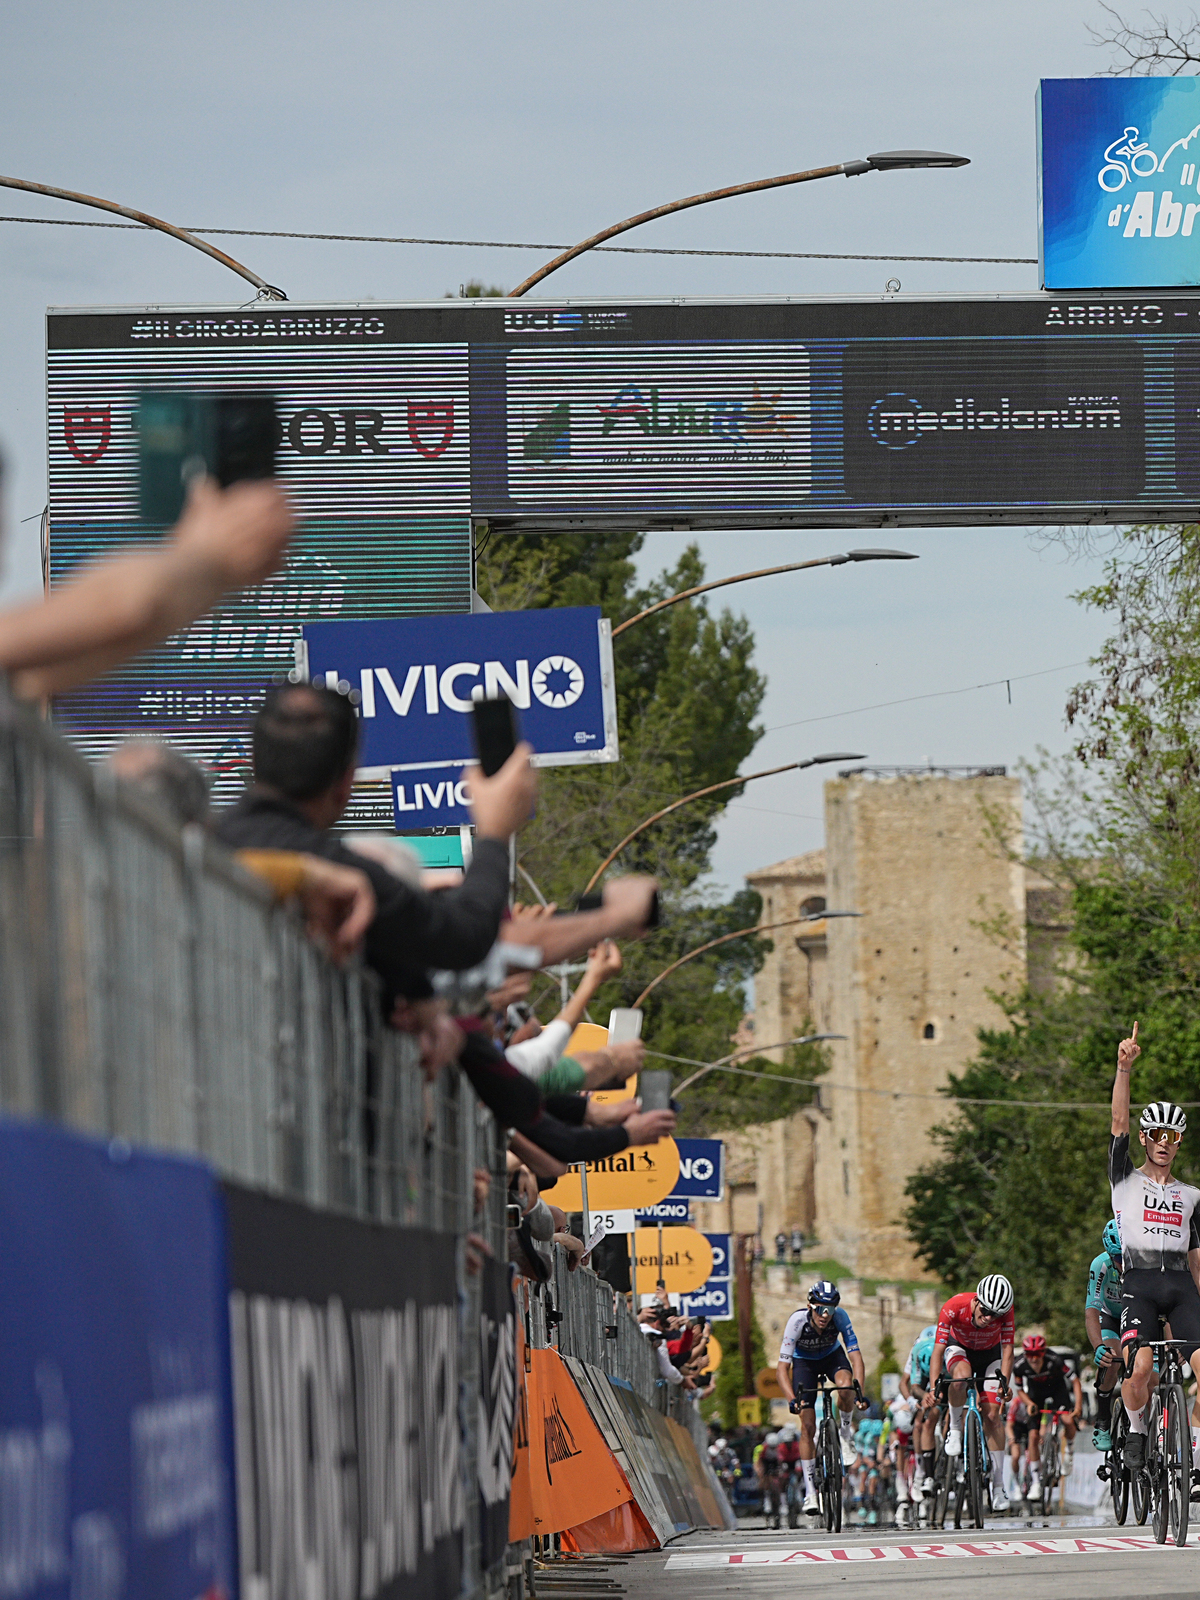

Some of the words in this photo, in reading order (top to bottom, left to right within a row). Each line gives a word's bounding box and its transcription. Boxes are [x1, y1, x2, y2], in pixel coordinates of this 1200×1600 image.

[1046, 304, 1164, 325] ARRIVO
[1144, 1195, 1183, 1213] UAE
[1147, 1213, 1179, 1223] Emirates
[1143, 1227, 1181, 1238] XRG
